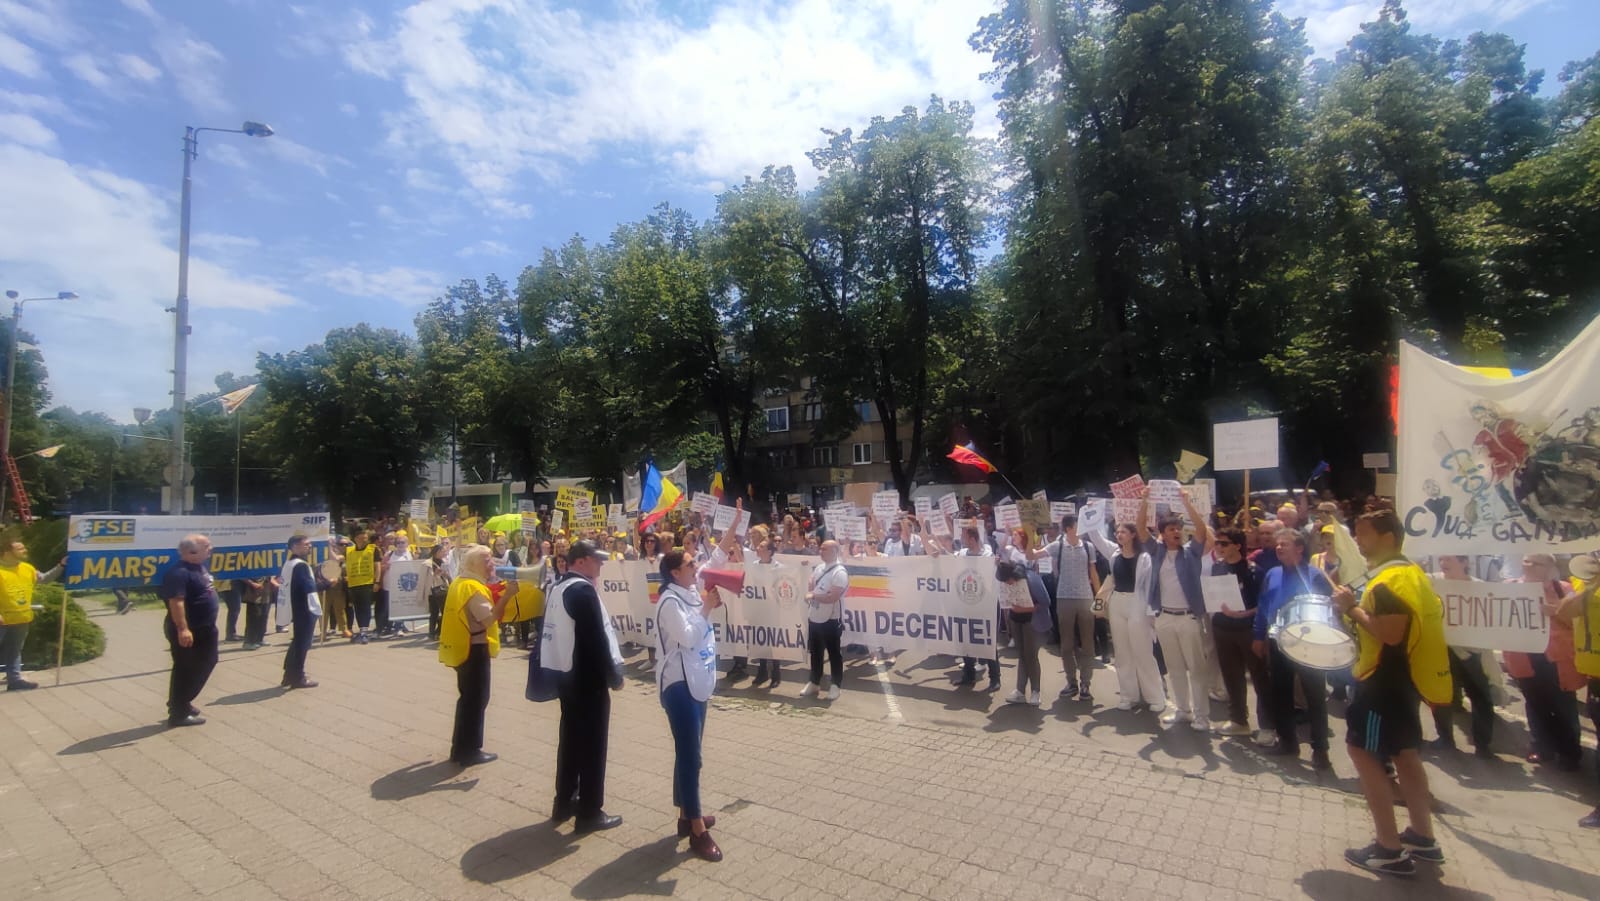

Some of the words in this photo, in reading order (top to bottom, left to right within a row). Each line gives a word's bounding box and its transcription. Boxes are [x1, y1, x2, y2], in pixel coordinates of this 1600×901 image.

[92, 519, 135, 535] FSE
[302, 515, 327, 525] SIIP
[917, 576, 951, 593] FSLI
[726, 622, 806, 651] NAȚIONALĂ
[875, 610, 992, 646] DECENTE!
